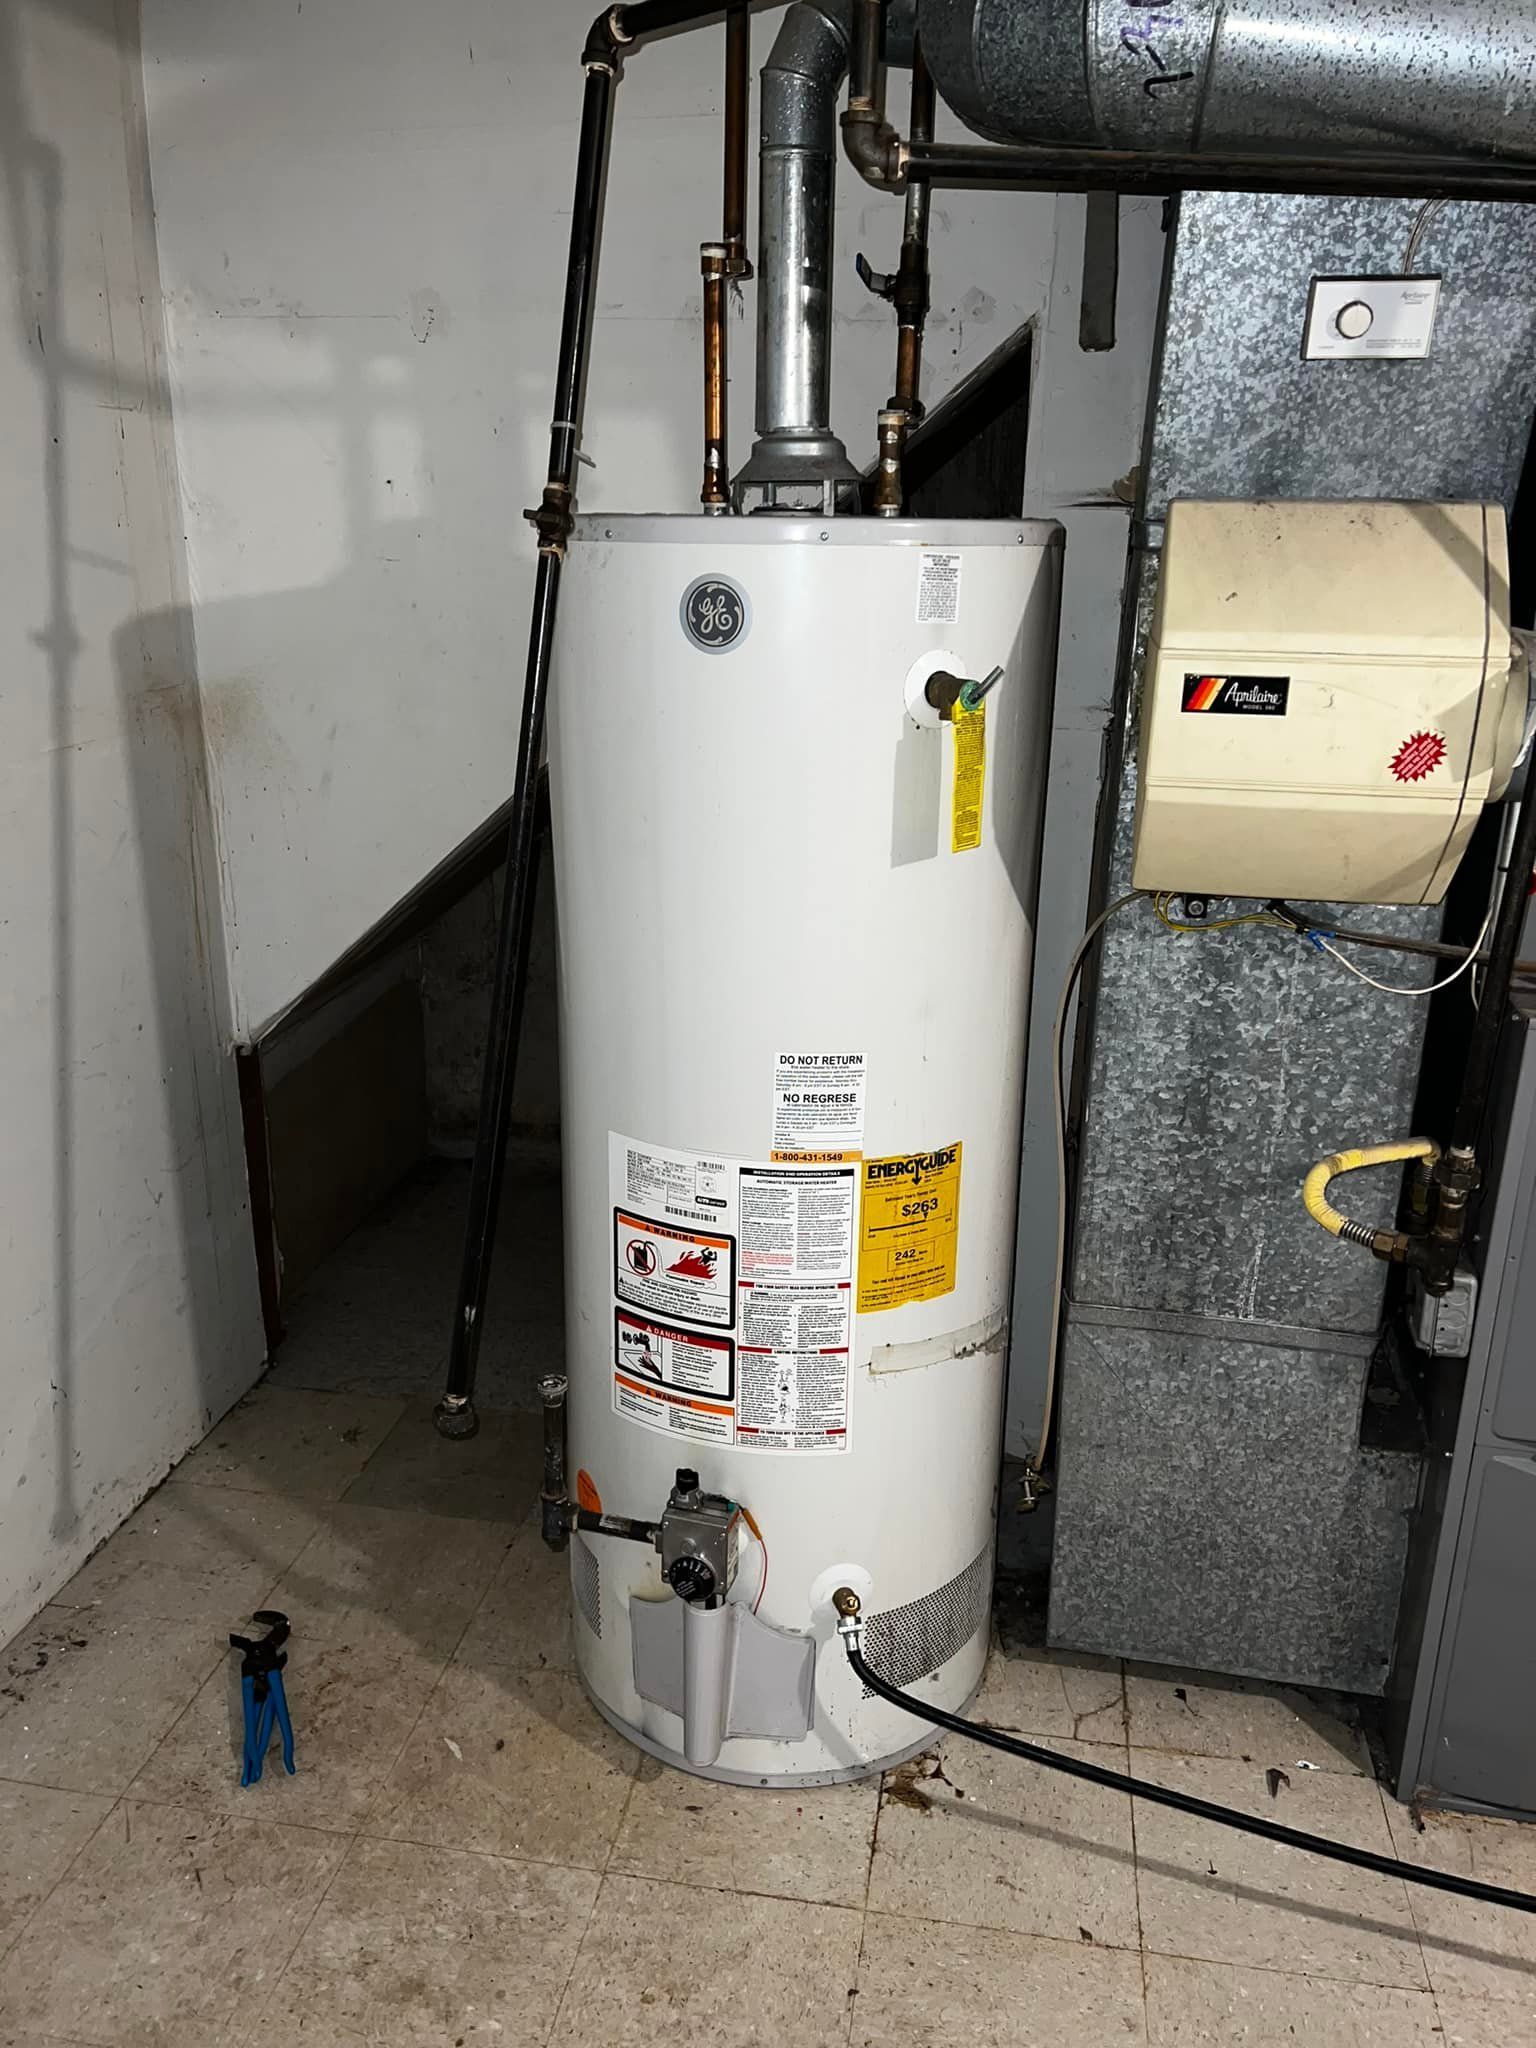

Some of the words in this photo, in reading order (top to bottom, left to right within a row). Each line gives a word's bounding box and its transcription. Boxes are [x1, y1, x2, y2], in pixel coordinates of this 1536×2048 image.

[699, 595, 732, 633] GE
[1224, 682, 1281, 707] Aprilaire
[780, 1055, 795, 1065] DO
[798, 1055, 820, 1065] NOT
[822, 1055, 863, 1065] RETURN
[783, 1093, 800, 1103] NO
[803, 1093, 857, 1103] REGRESE
[774, 1153, 843, 1161] 1-800-431-1549
[868, 1149, 957, 1179] ENERGYGUIDE
[902, 1198, 938, 1217] $263
[653, 1226, 695, 1242] WARNING
[895, 1249, 917, 1261] 242
[654, 1328, 689, 1343] DANGER
[655, 1389, 692, 1407] WARNING
